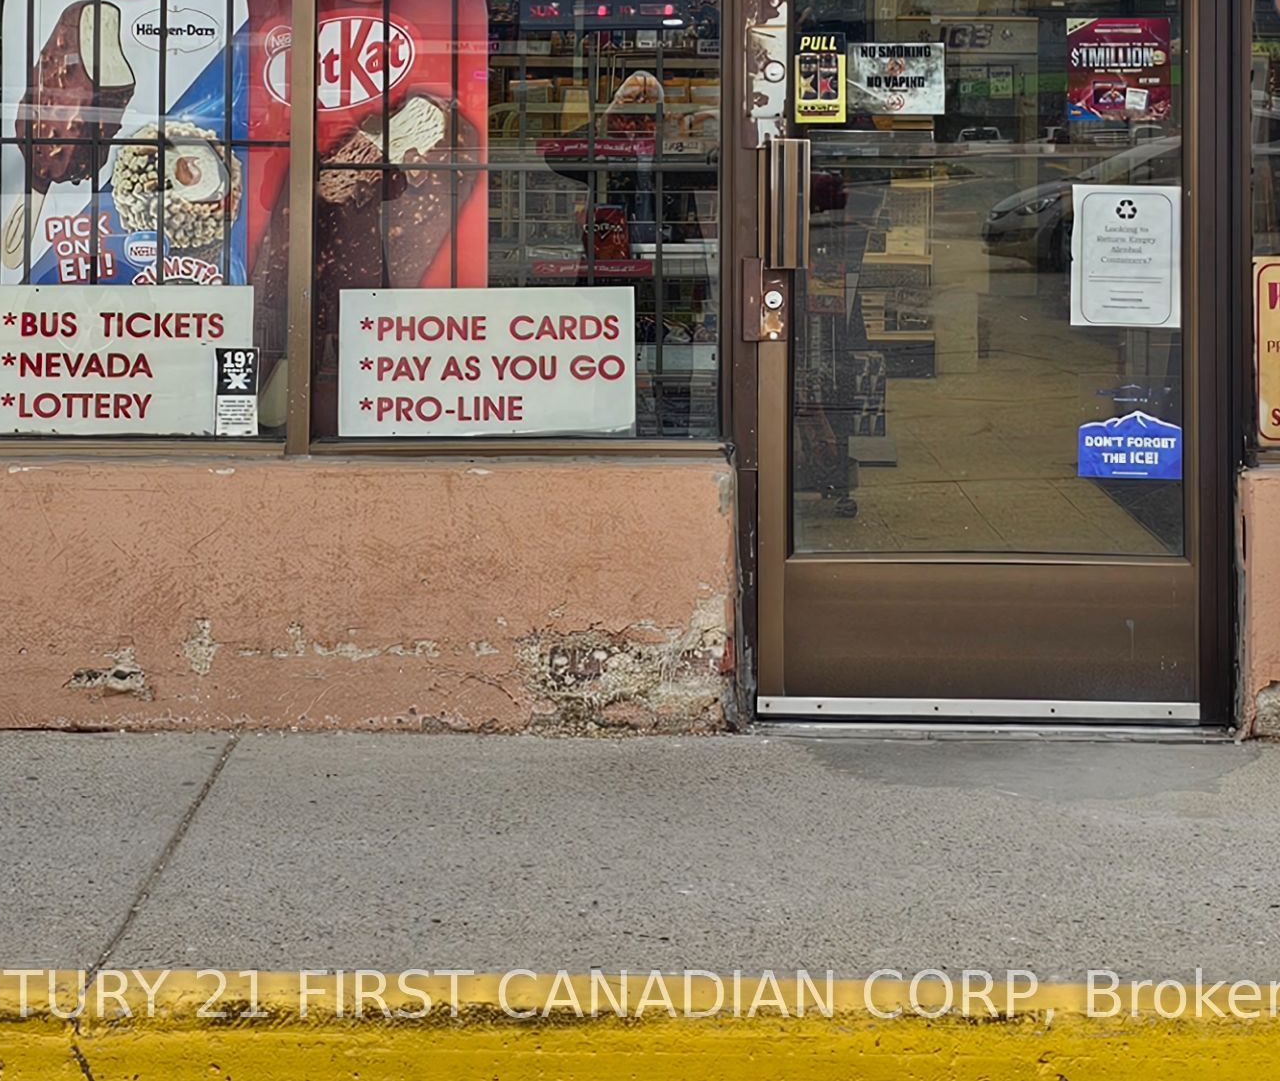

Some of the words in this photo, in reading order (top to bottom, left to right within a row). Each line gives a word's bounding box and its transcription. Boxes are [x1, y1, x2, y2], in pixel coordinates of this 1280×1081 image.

[800, 36, 837, 51] PULL
[939, 23, 994, 49] ICE
[860, 46, 875, 58] NO
[878, 46, 932, 58] SMOKING
[866, 76, 881, 88] NO
[883, 76, 926, 88] VAPING
[48, 215, 110, 240] PICK
[1104, 225, 1138, 235] Looking
[102, 311, 225, 339] TICKETS
[509, 316, 620, 341] CARDS
[440, 356, 481, 381] AS
[492, 356, 558, 381] YOU
[569, 356, 626, 381] GO
[1084, 435, 1124, 448] DON'T
[1127, 437, 1177, 449] FORGET
[1101, 452, 1127, 464] THE
[1130, 451, 1159, 465] ICE!
